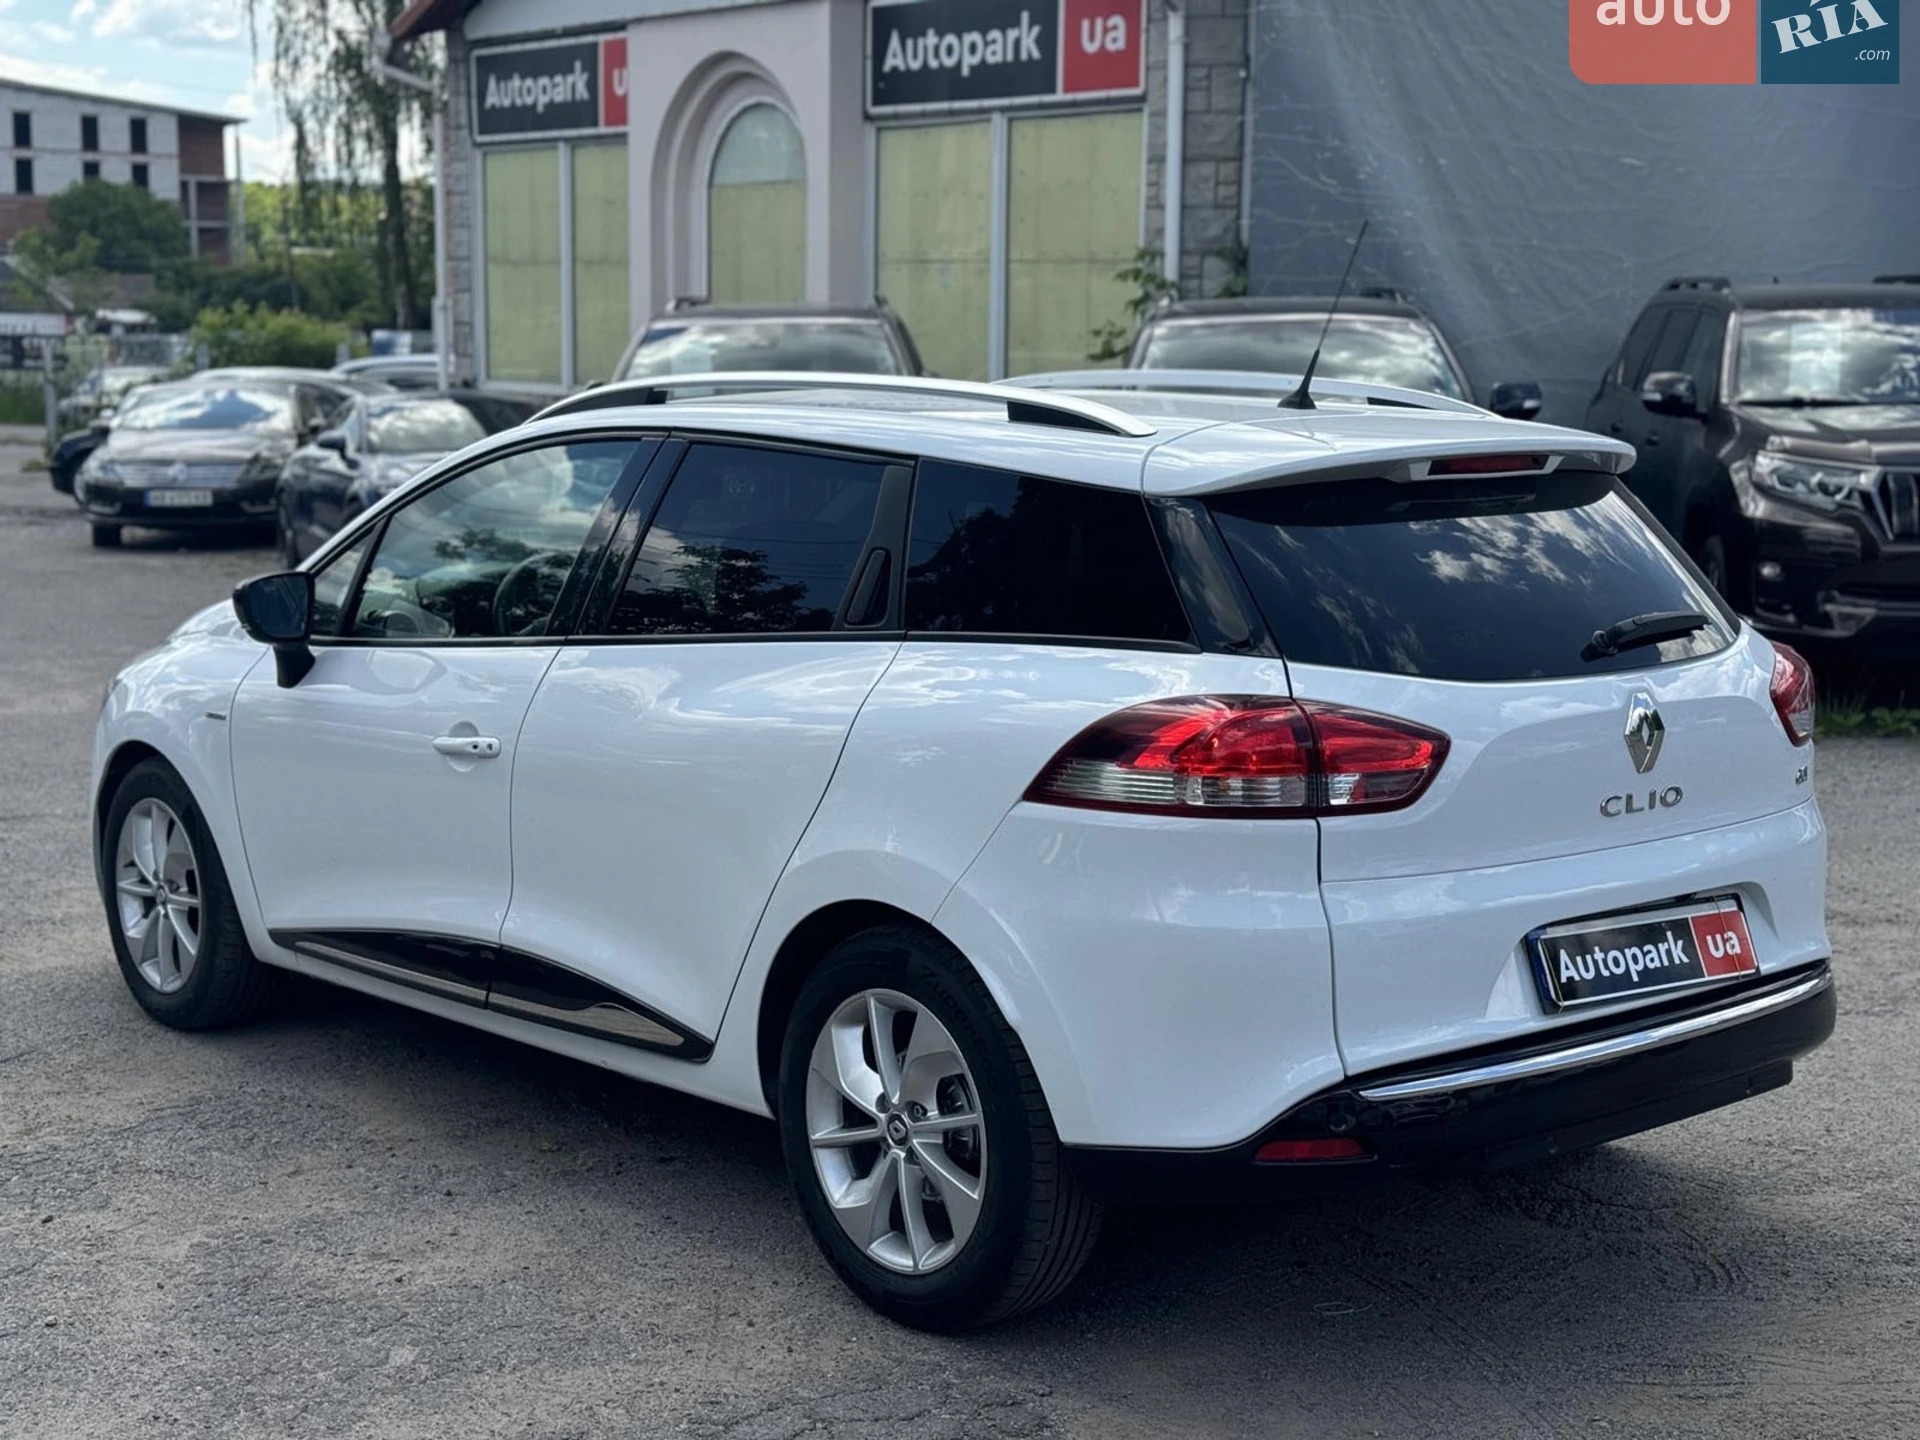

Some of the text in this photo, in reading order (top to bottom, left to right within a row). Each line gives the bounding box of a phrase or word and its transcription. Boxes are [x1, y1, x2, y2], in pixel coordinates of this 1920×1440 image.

[882, 9, 1126, 78] Autopark ua
[484, 58, 591, 115] Autopark
[1600, 786, 1683, 817] CLIO
[1559, 930, 1742, 983] Autopark ua
